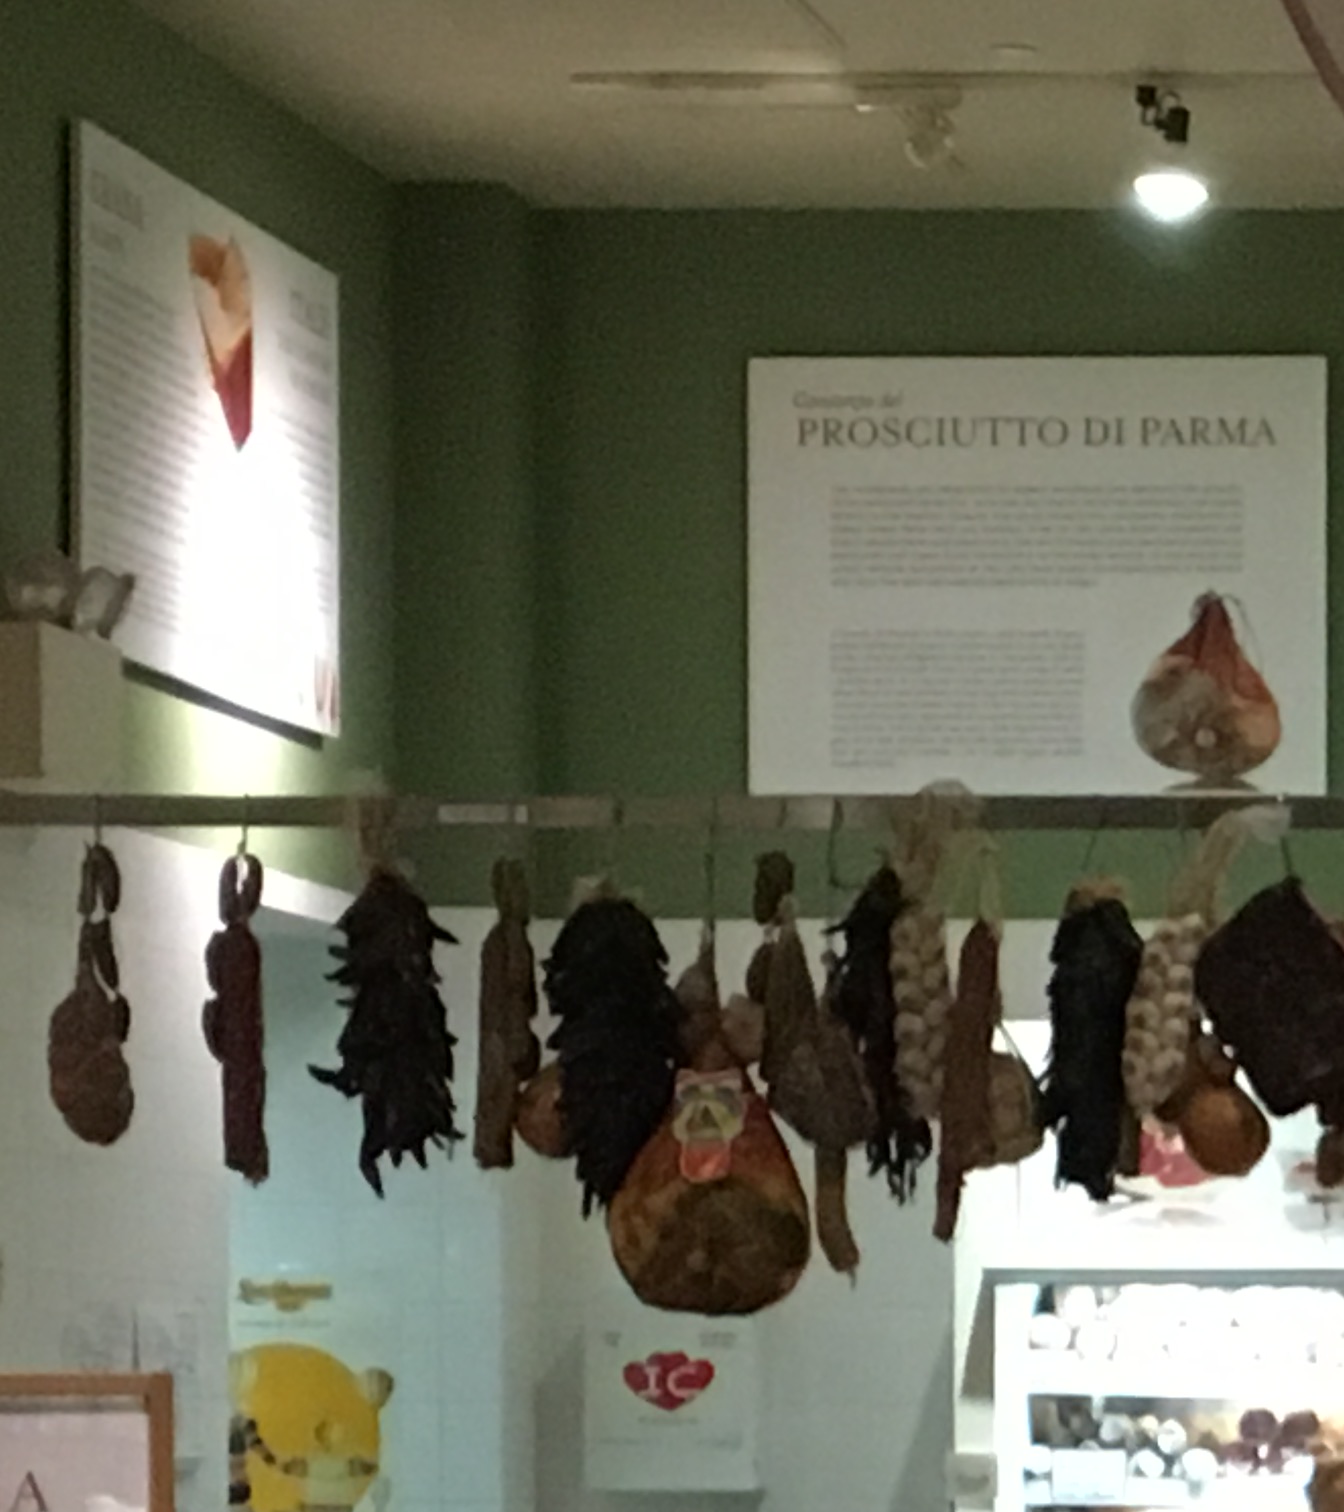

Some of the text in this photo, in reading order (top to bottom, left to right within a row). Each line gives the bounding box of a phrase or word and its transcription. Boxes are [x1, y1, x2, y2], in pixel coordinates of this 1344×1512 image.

[797, 415, 1277, 447] PROSCIUTTO DI PARMA
